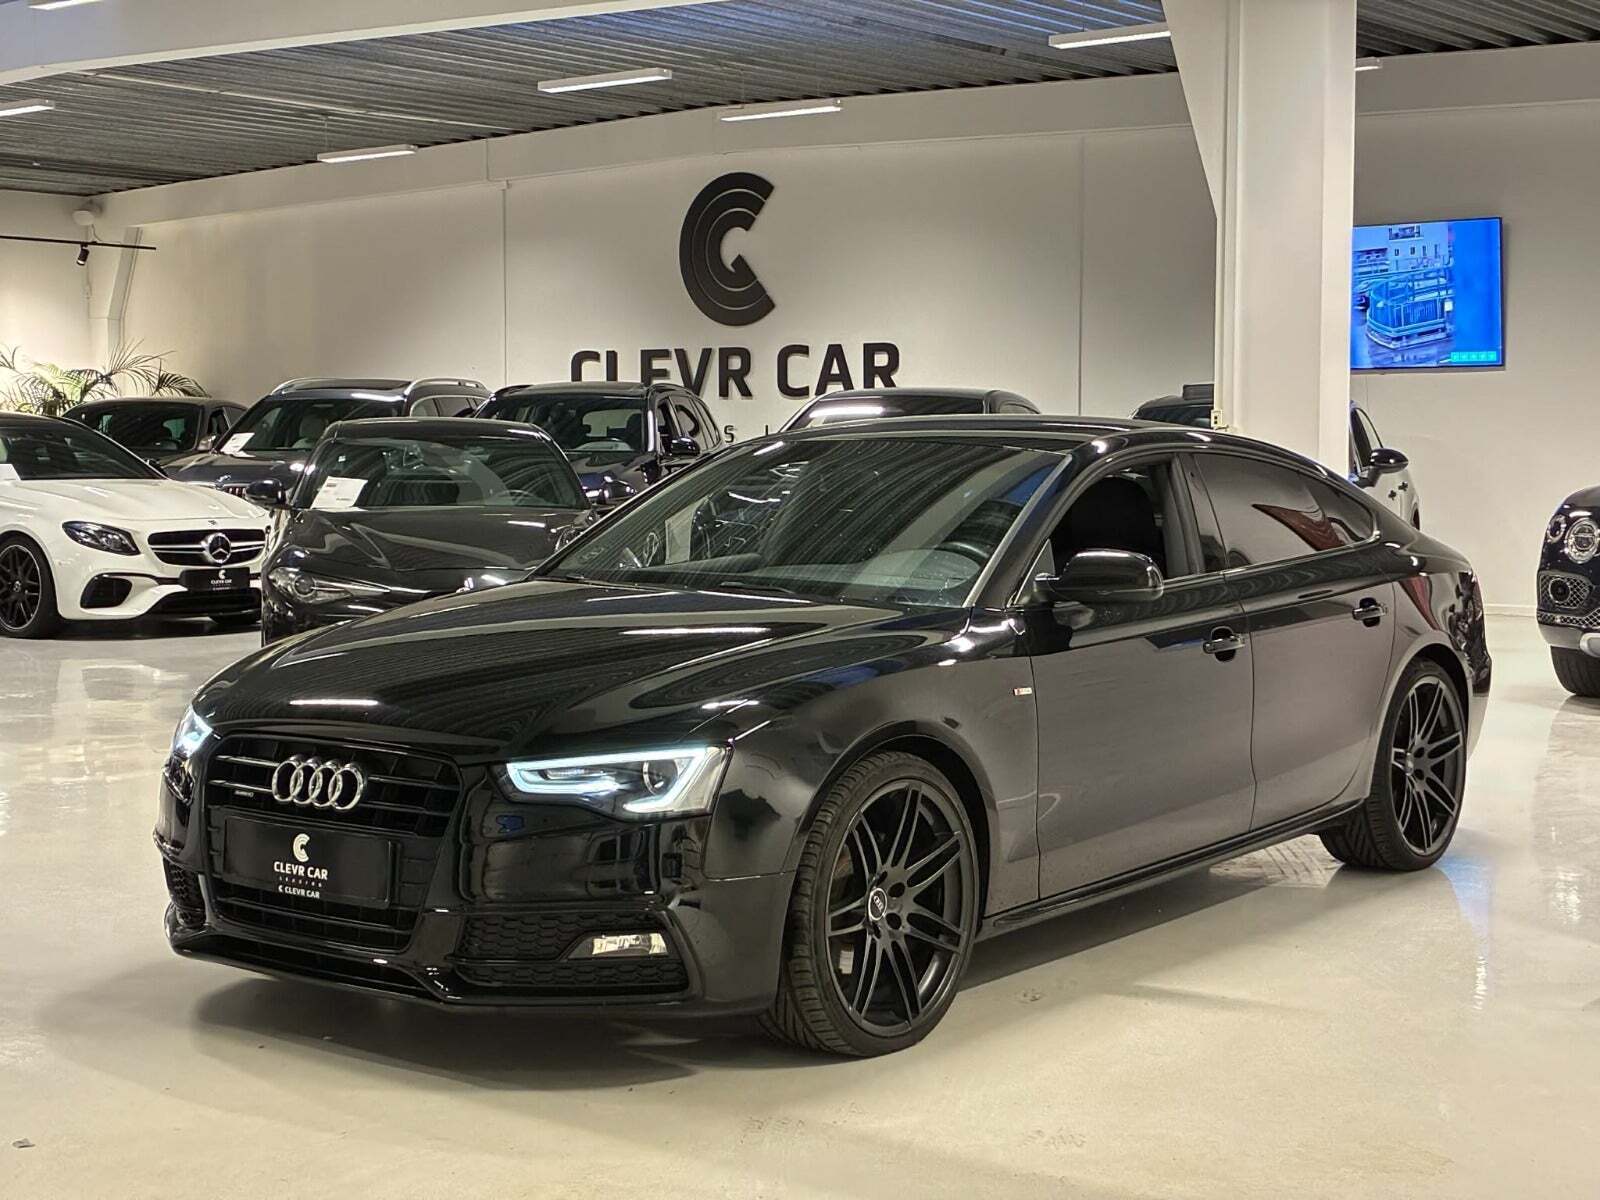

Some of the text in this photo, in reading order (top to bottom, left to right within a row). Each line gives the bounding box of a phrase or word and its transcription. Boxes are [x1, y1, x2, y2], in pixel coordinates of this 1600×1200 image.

[777, 343, 900, 396] CAR
[273, 861, 328, 880] CLEVR CAR
[285, 886, 305, 896] CLEVR
[306, 890, 320, 899] CAR
